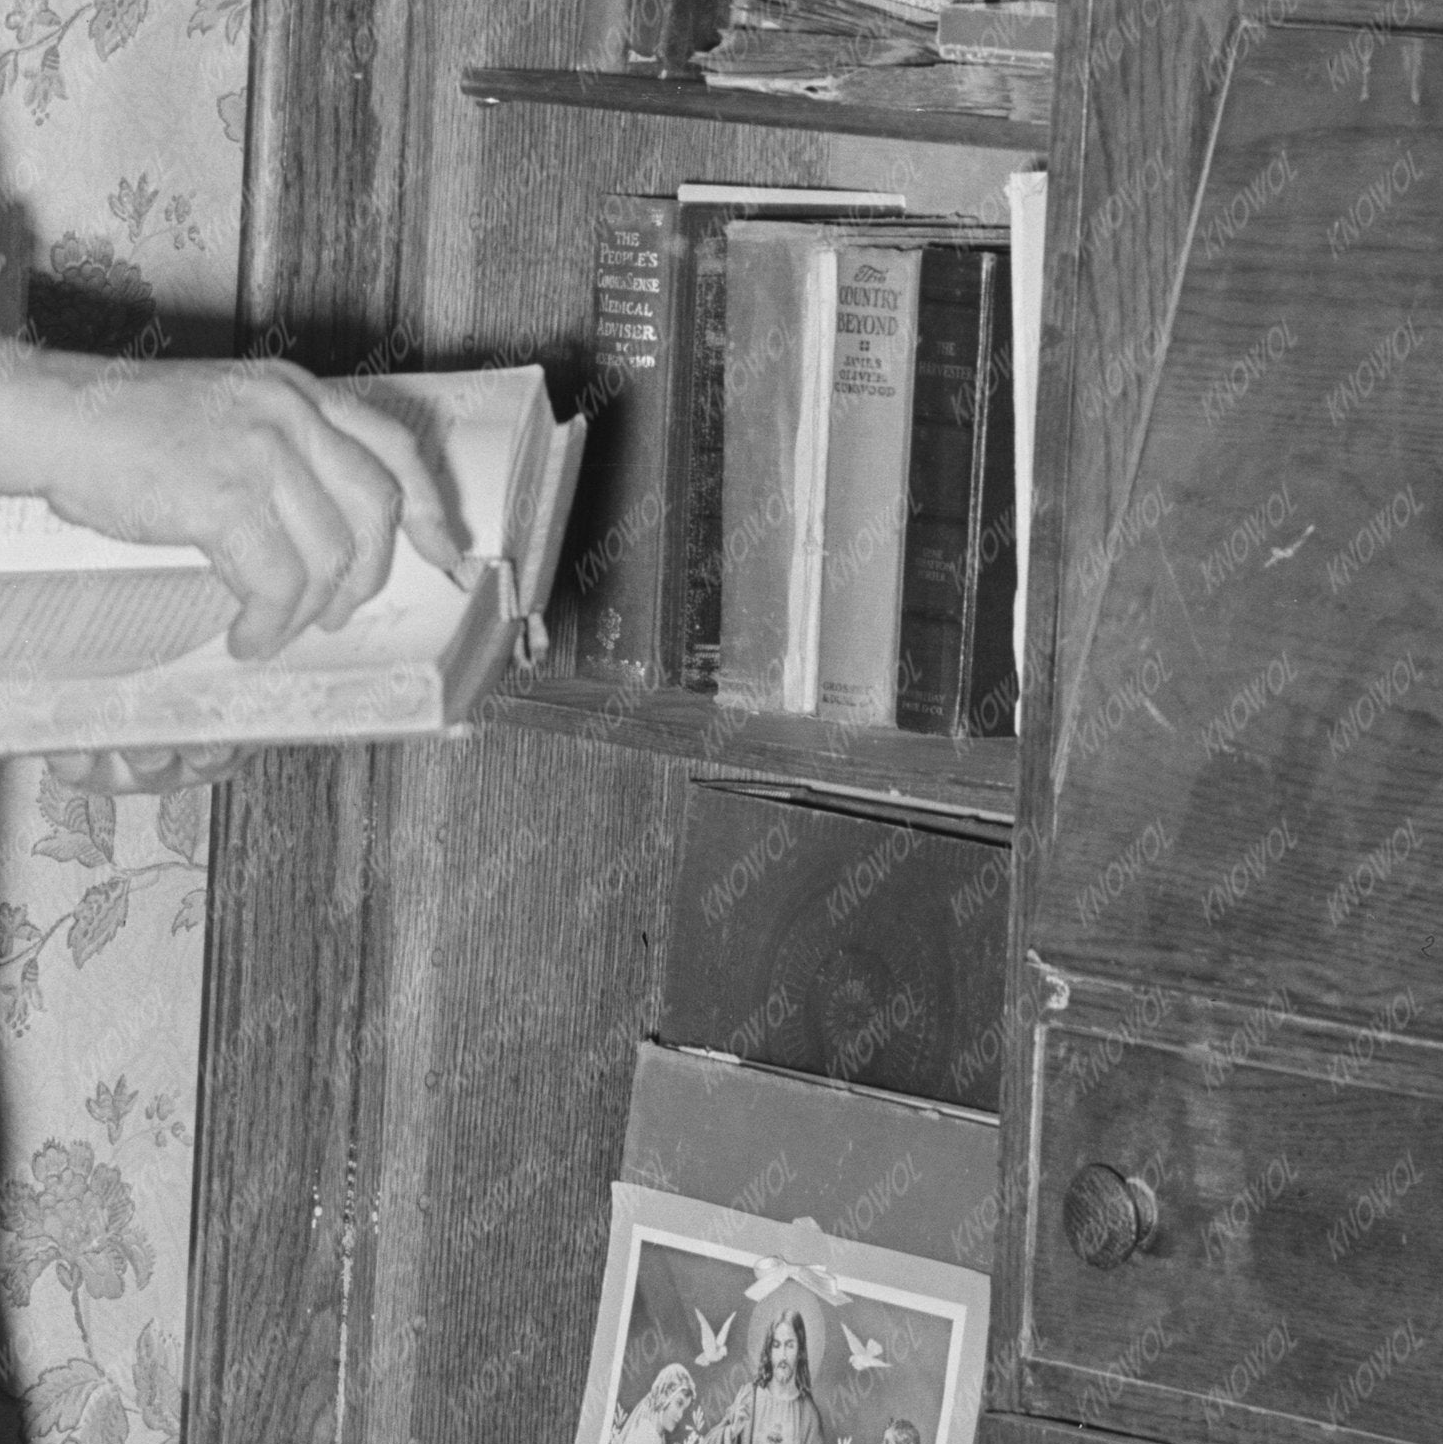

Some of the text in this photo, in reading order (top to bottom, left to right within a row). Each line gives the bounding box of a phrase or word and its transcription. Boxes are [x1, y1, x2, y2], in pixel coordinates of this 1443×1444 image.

[614, 231, 640, 247] THE
[599, 294, 654, 318] MEDICAL
[839, 285, 901, 311] COUNTRY
[596, 317, 658, 341] ADVISER
[837, 312, 899, 336] BEYOND
